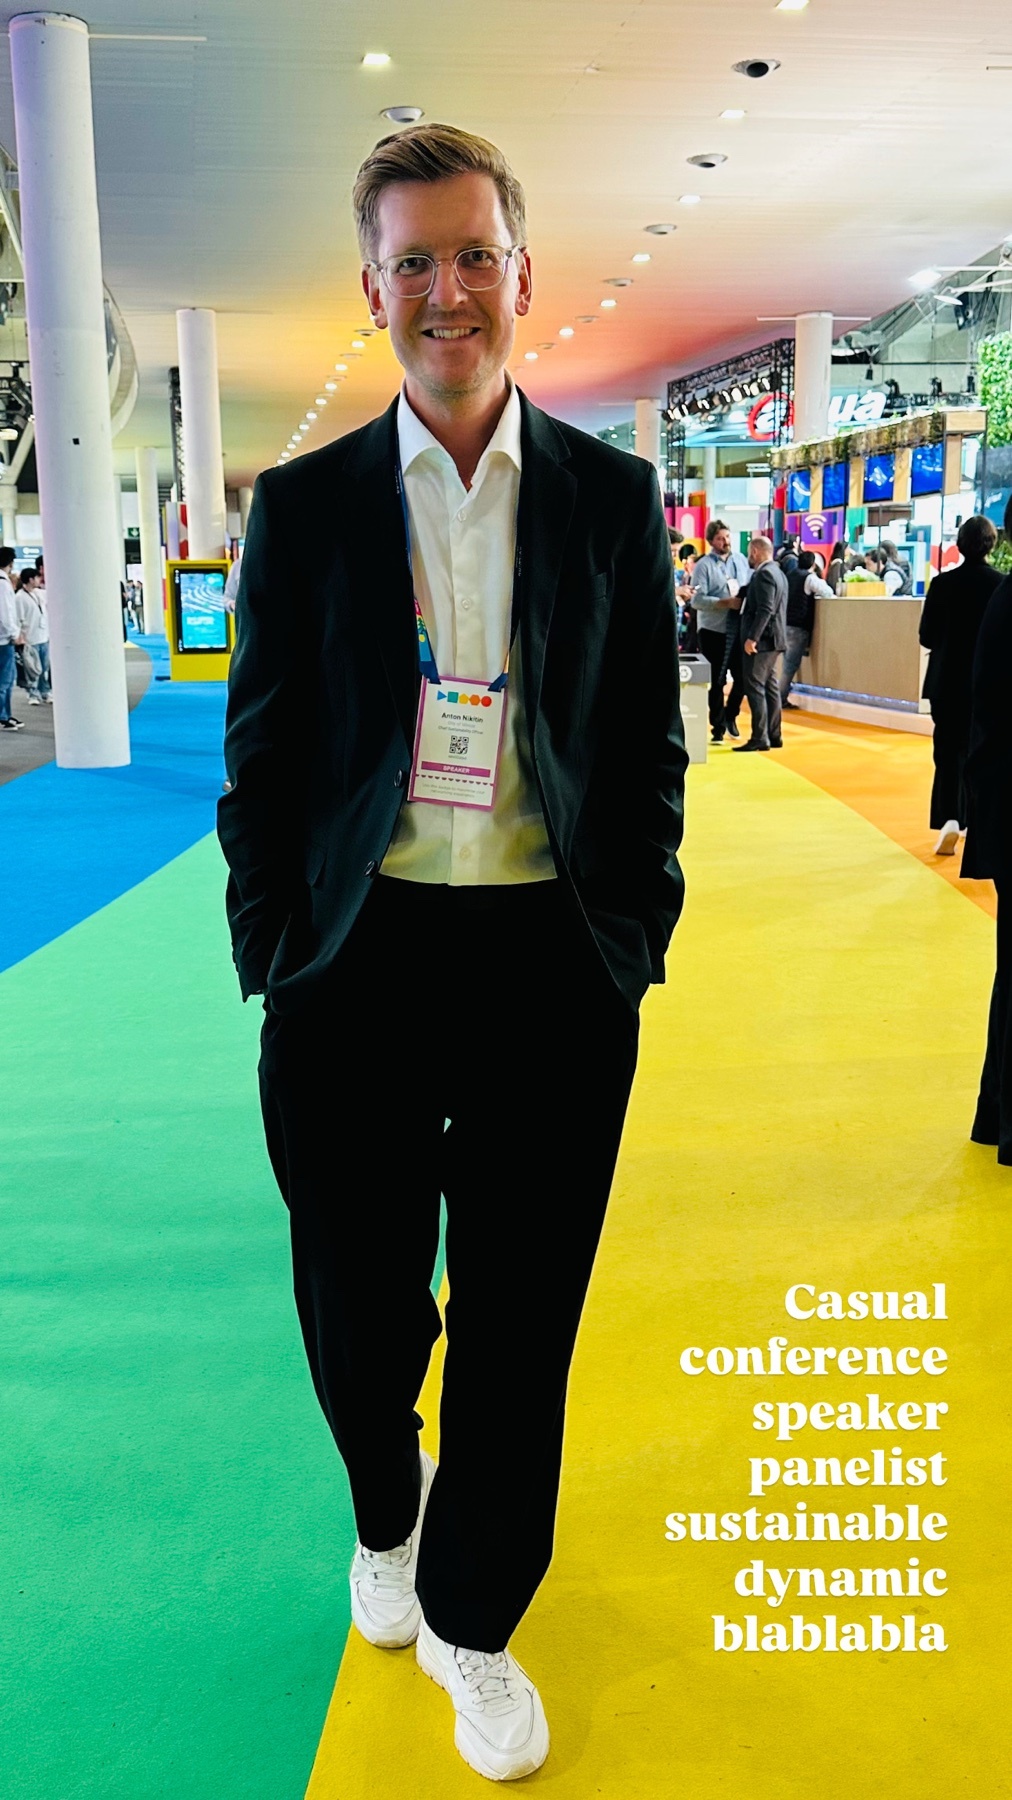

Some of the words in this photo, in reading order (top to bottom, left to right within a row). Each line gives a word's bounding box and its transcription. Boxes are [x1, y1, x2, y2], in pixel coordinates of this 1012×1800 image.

[441, 712, 461, 720] Anton
[462, 714, 484, 723] Nikitin
[442, 765, 470, 774] SPEAKER
